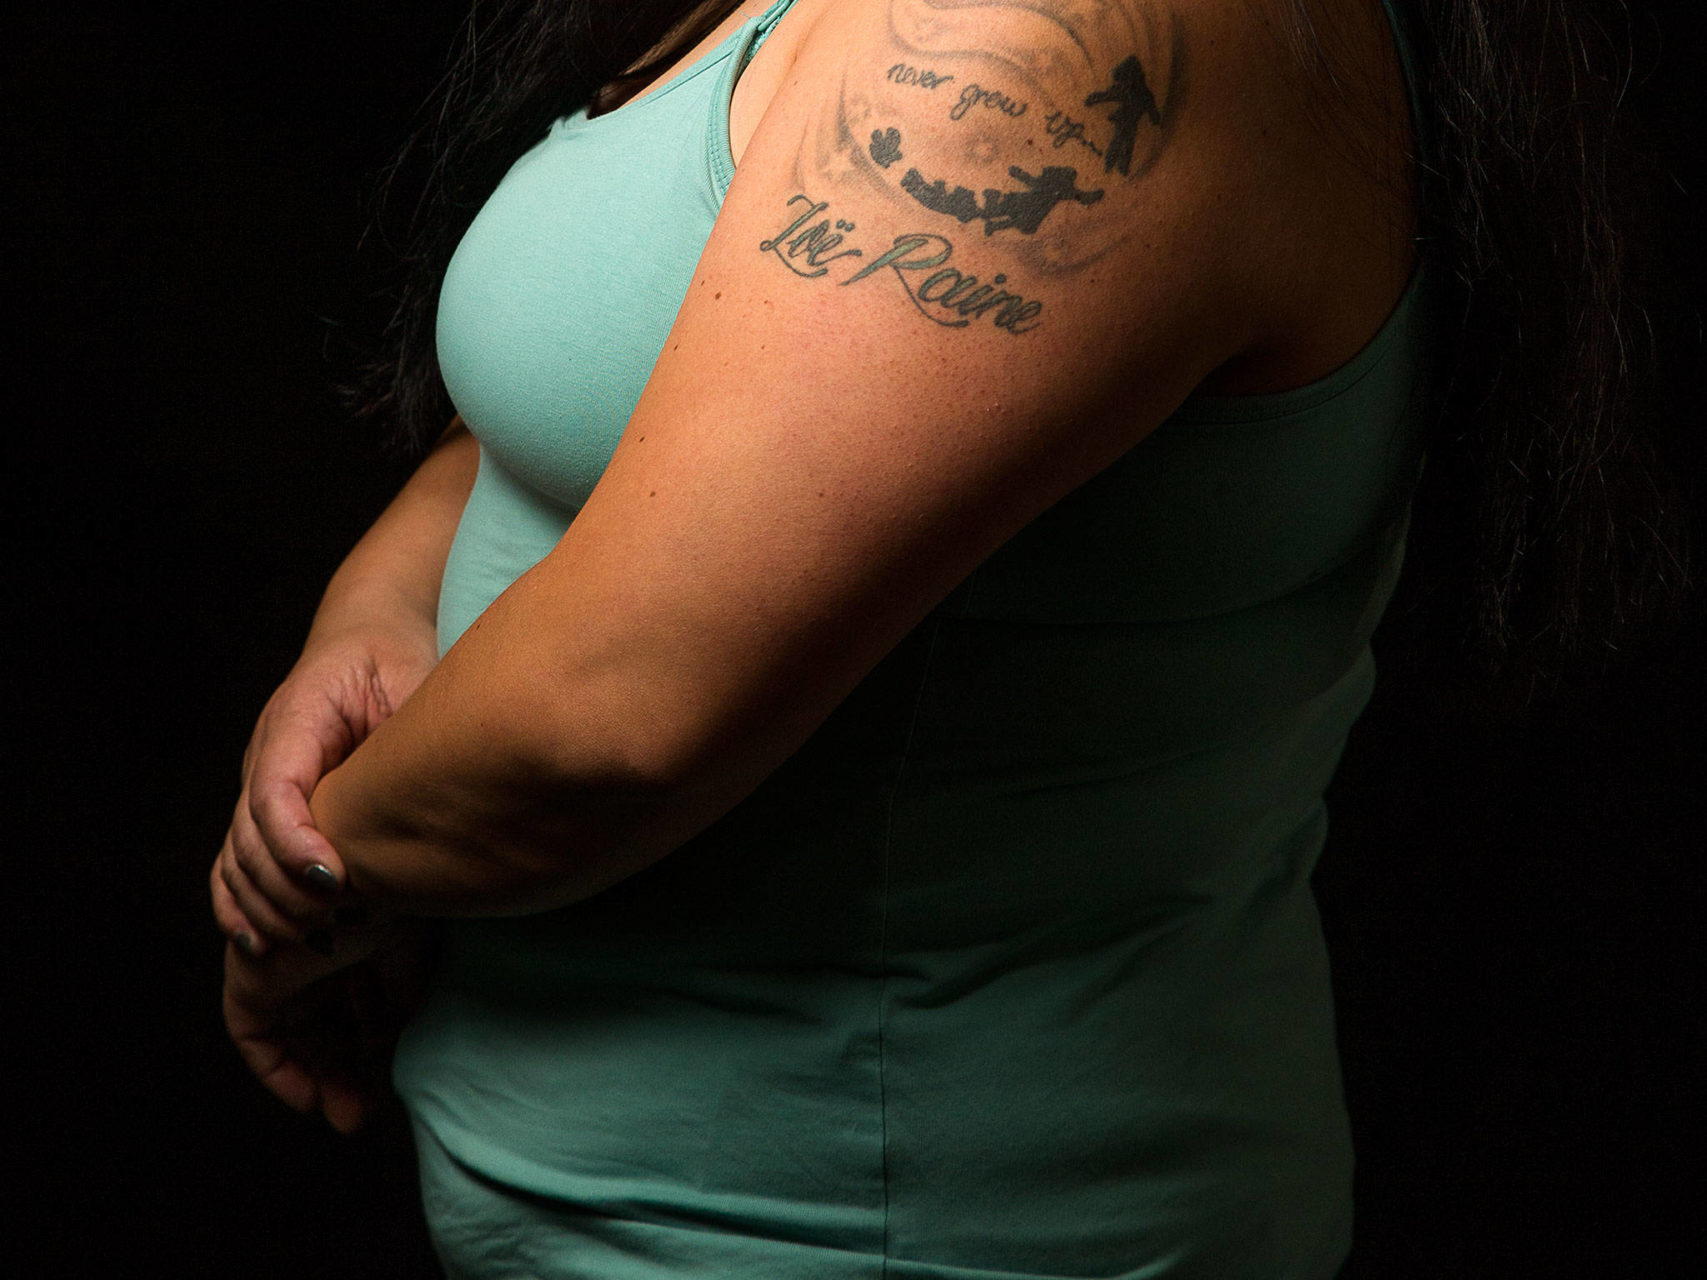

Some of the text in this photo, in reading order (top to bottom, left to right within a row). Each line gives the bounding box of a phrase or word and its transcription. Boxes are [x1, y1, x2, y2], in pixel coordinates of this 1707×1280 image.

[887, 63, 954, 89] never
[950, 83, 1028, 121] grow
[840, 233, 1043, 335] Raine
